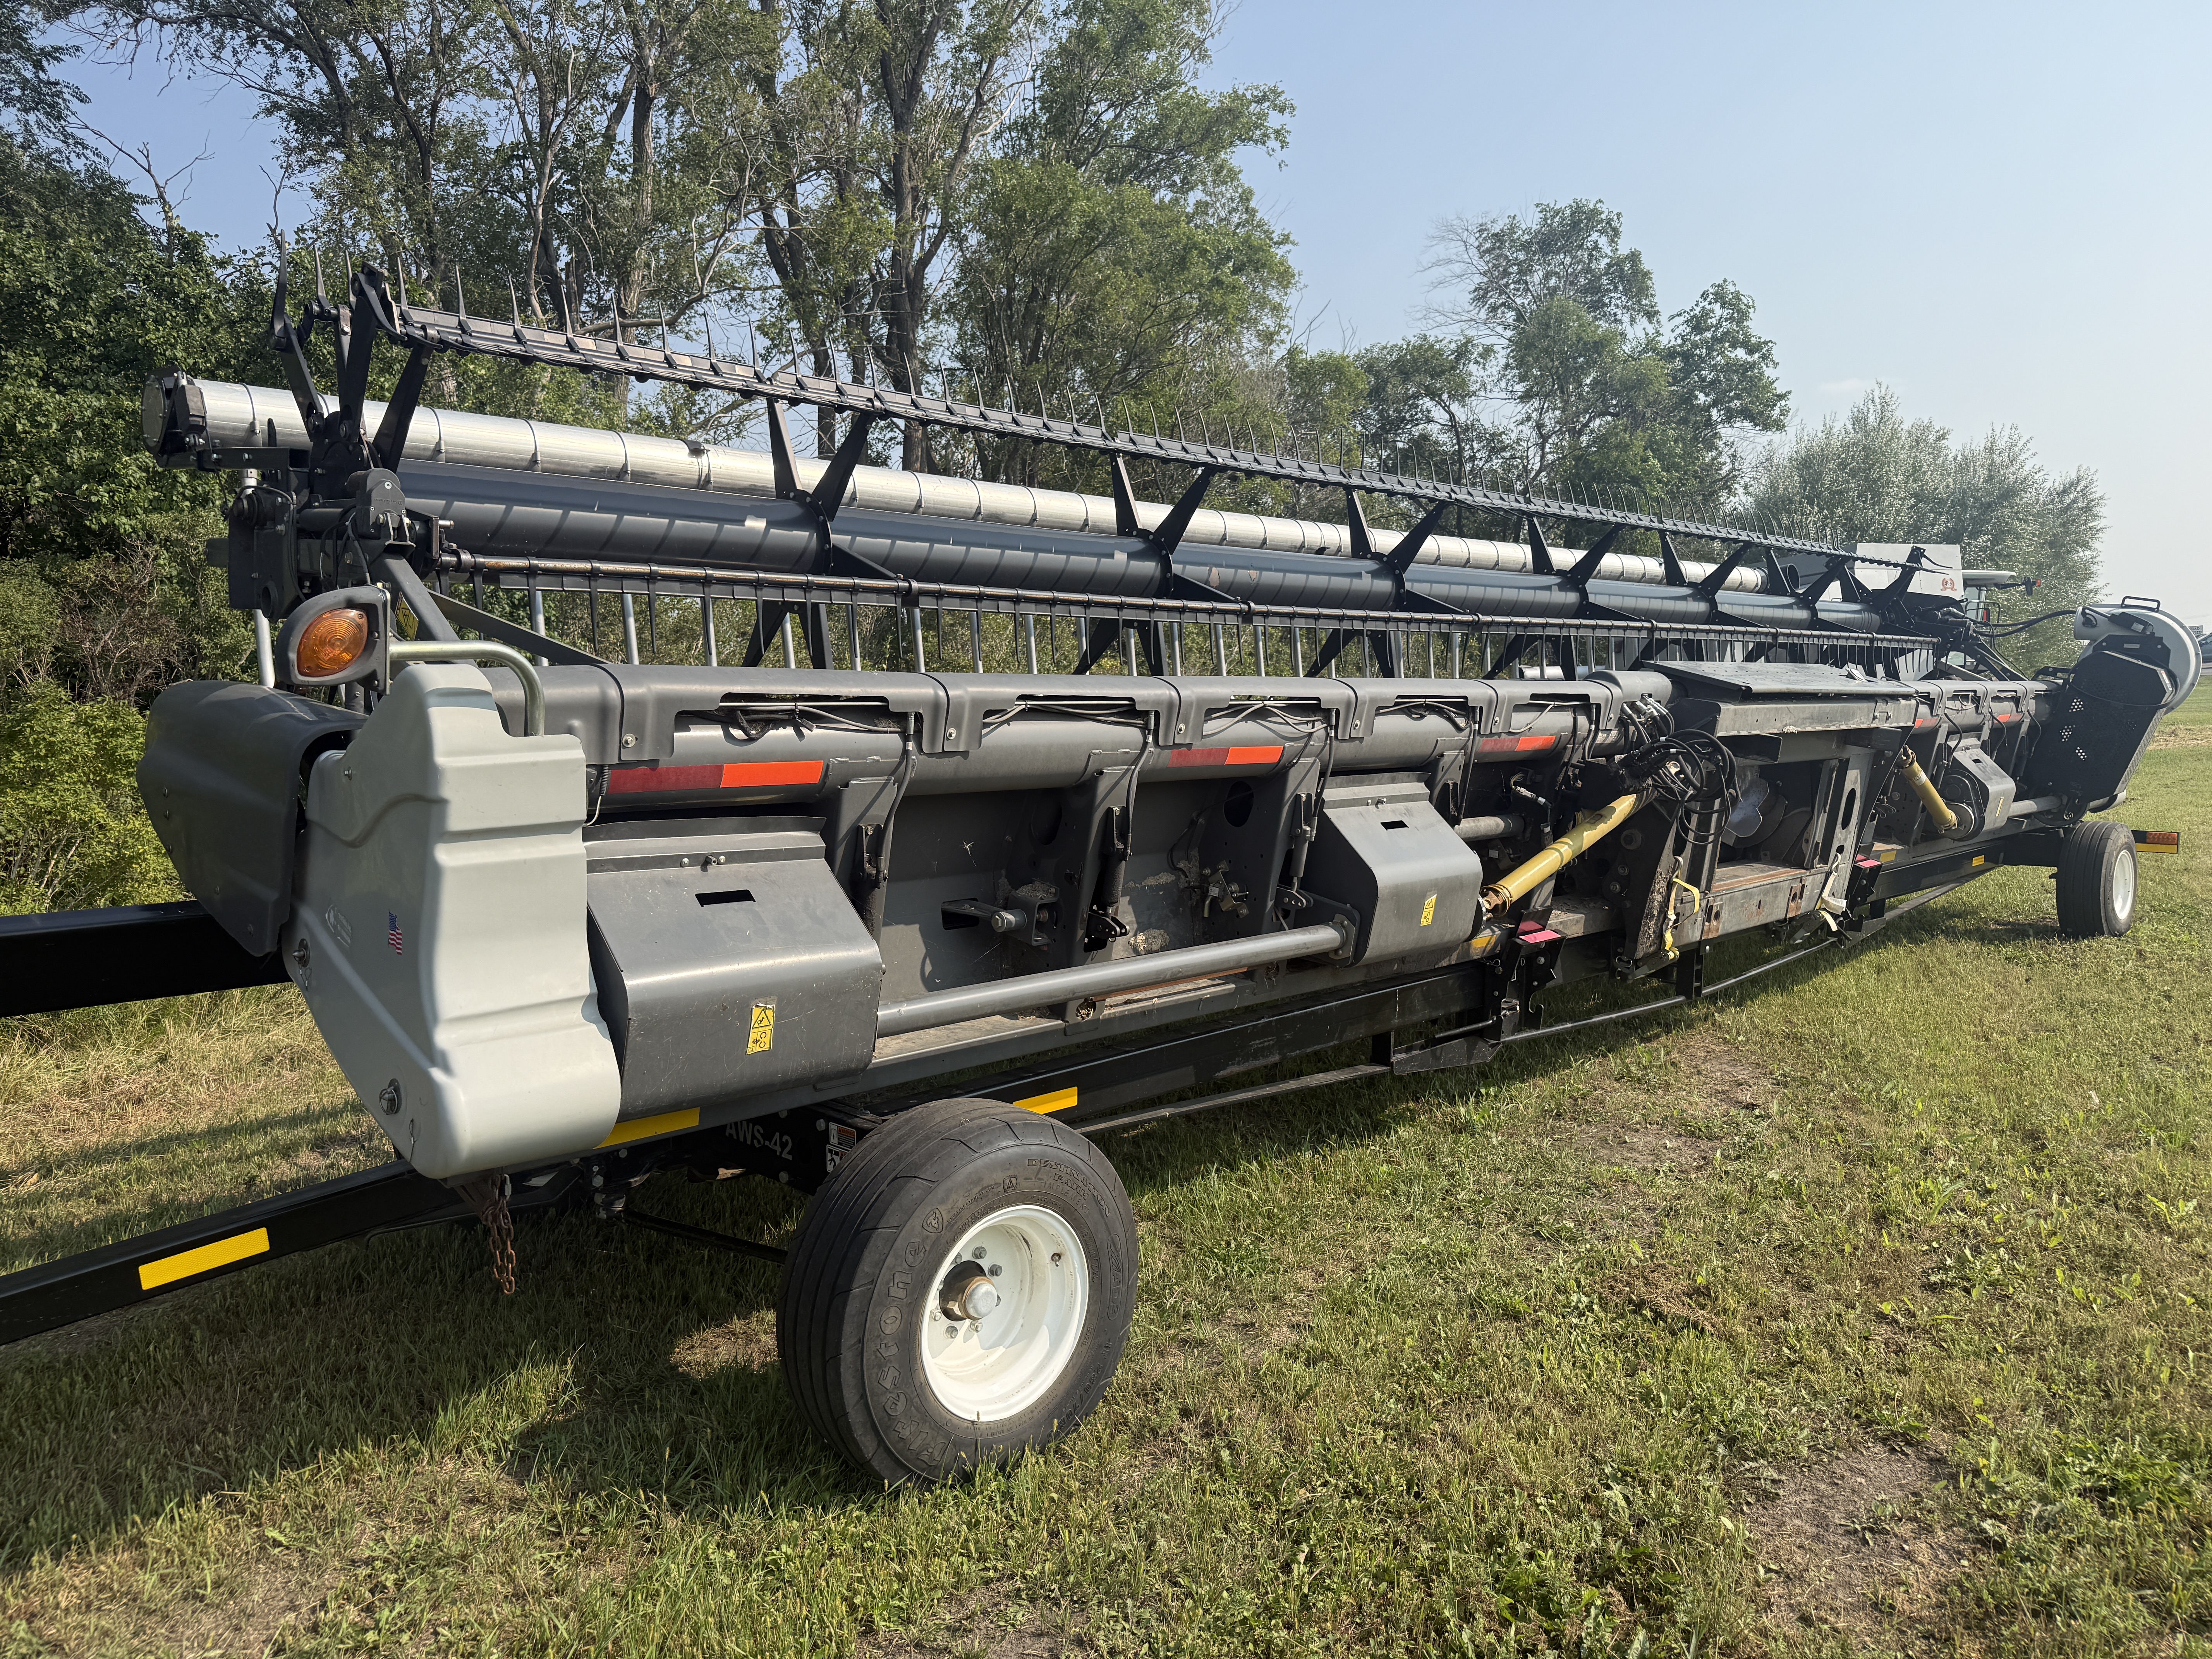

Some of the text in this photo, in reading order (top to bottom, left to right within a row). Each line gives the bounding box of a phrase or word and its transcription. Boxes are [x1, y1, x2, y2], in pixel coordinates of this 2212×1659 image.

[726, 1120, 792, 1161] AWS-42
[1027, 1158, 1110, 1218] DESTINATION
[1044, 1181, 1090, 1214] IMPLEMENT
[1053, 1173, 1089, 1201] FARM
[876, 1241, 946, 1466] Firestone
[1047, 1362, 1103, 1440] 280/70R5
